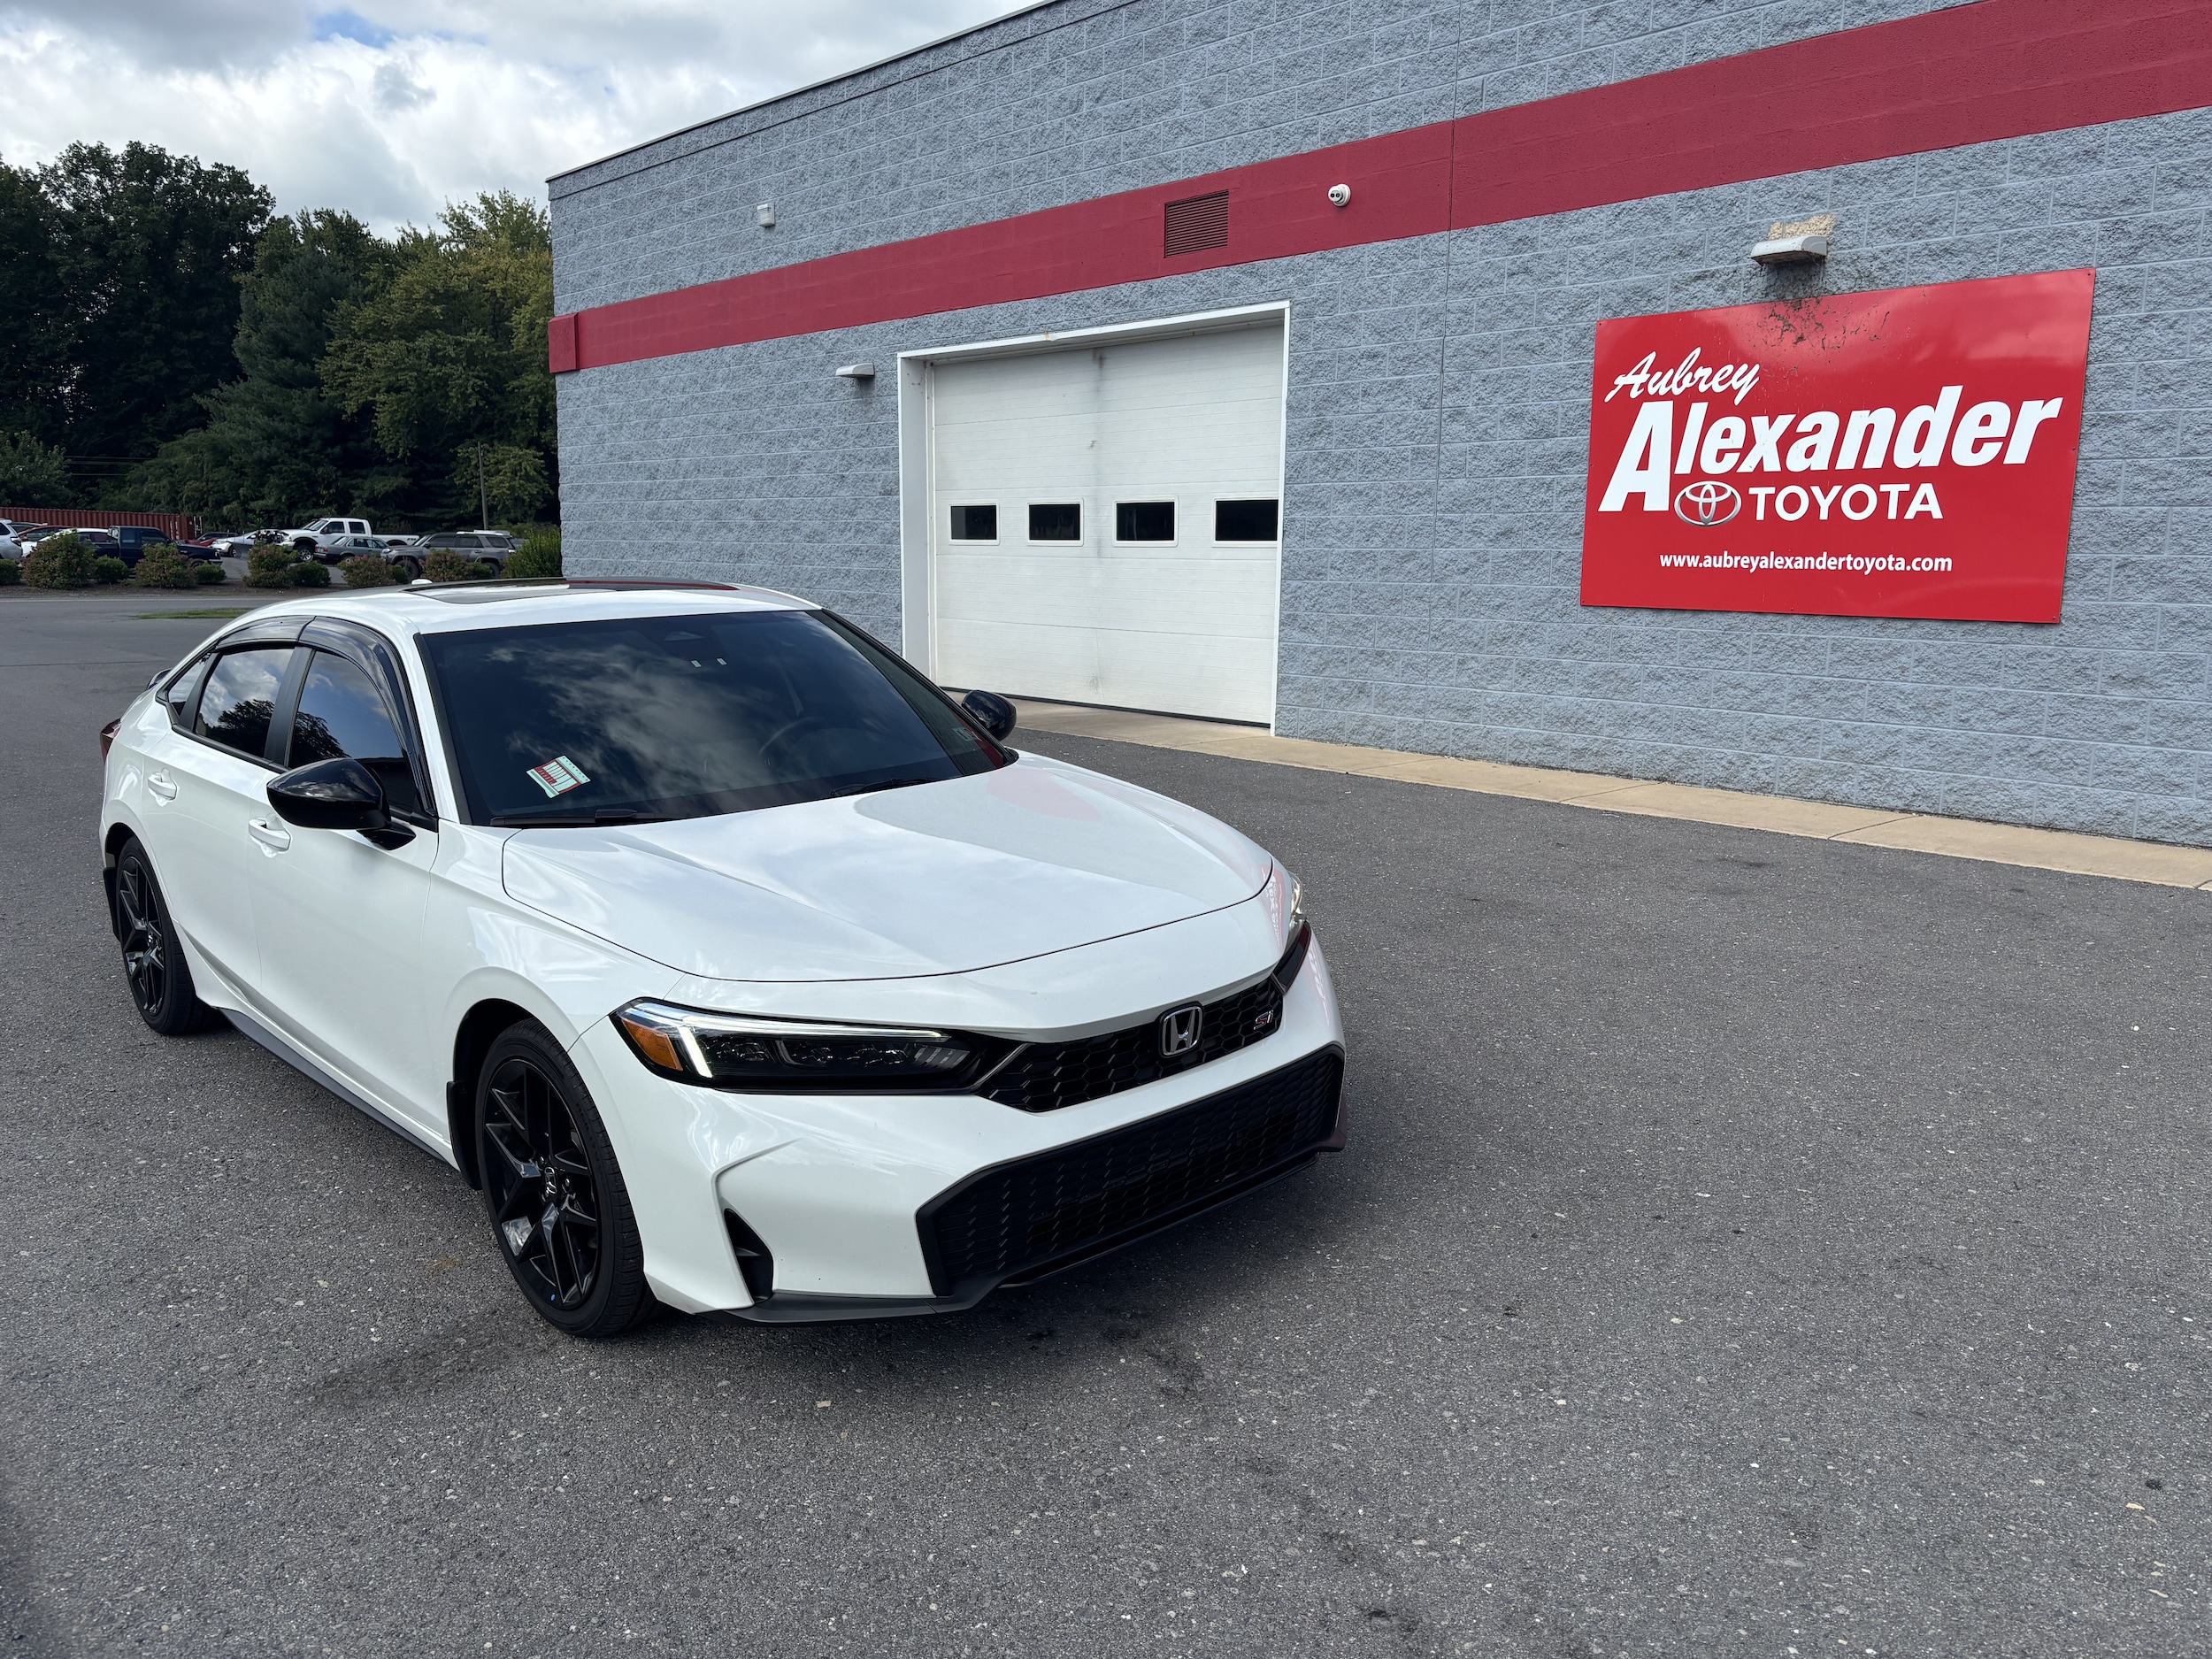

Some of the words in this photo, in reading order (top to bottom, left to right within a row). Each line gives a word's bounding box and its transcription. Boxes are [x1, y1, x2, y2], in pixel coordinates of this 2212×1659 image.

[1604, 347, 1760, 405] Aubrey
[1598, 385, 2063, 512] Alexander
[1748, 483, 1944, 521] TOYOTA
[1660, 550, 1953, 576] www.aubreyalexandertoyota.com
